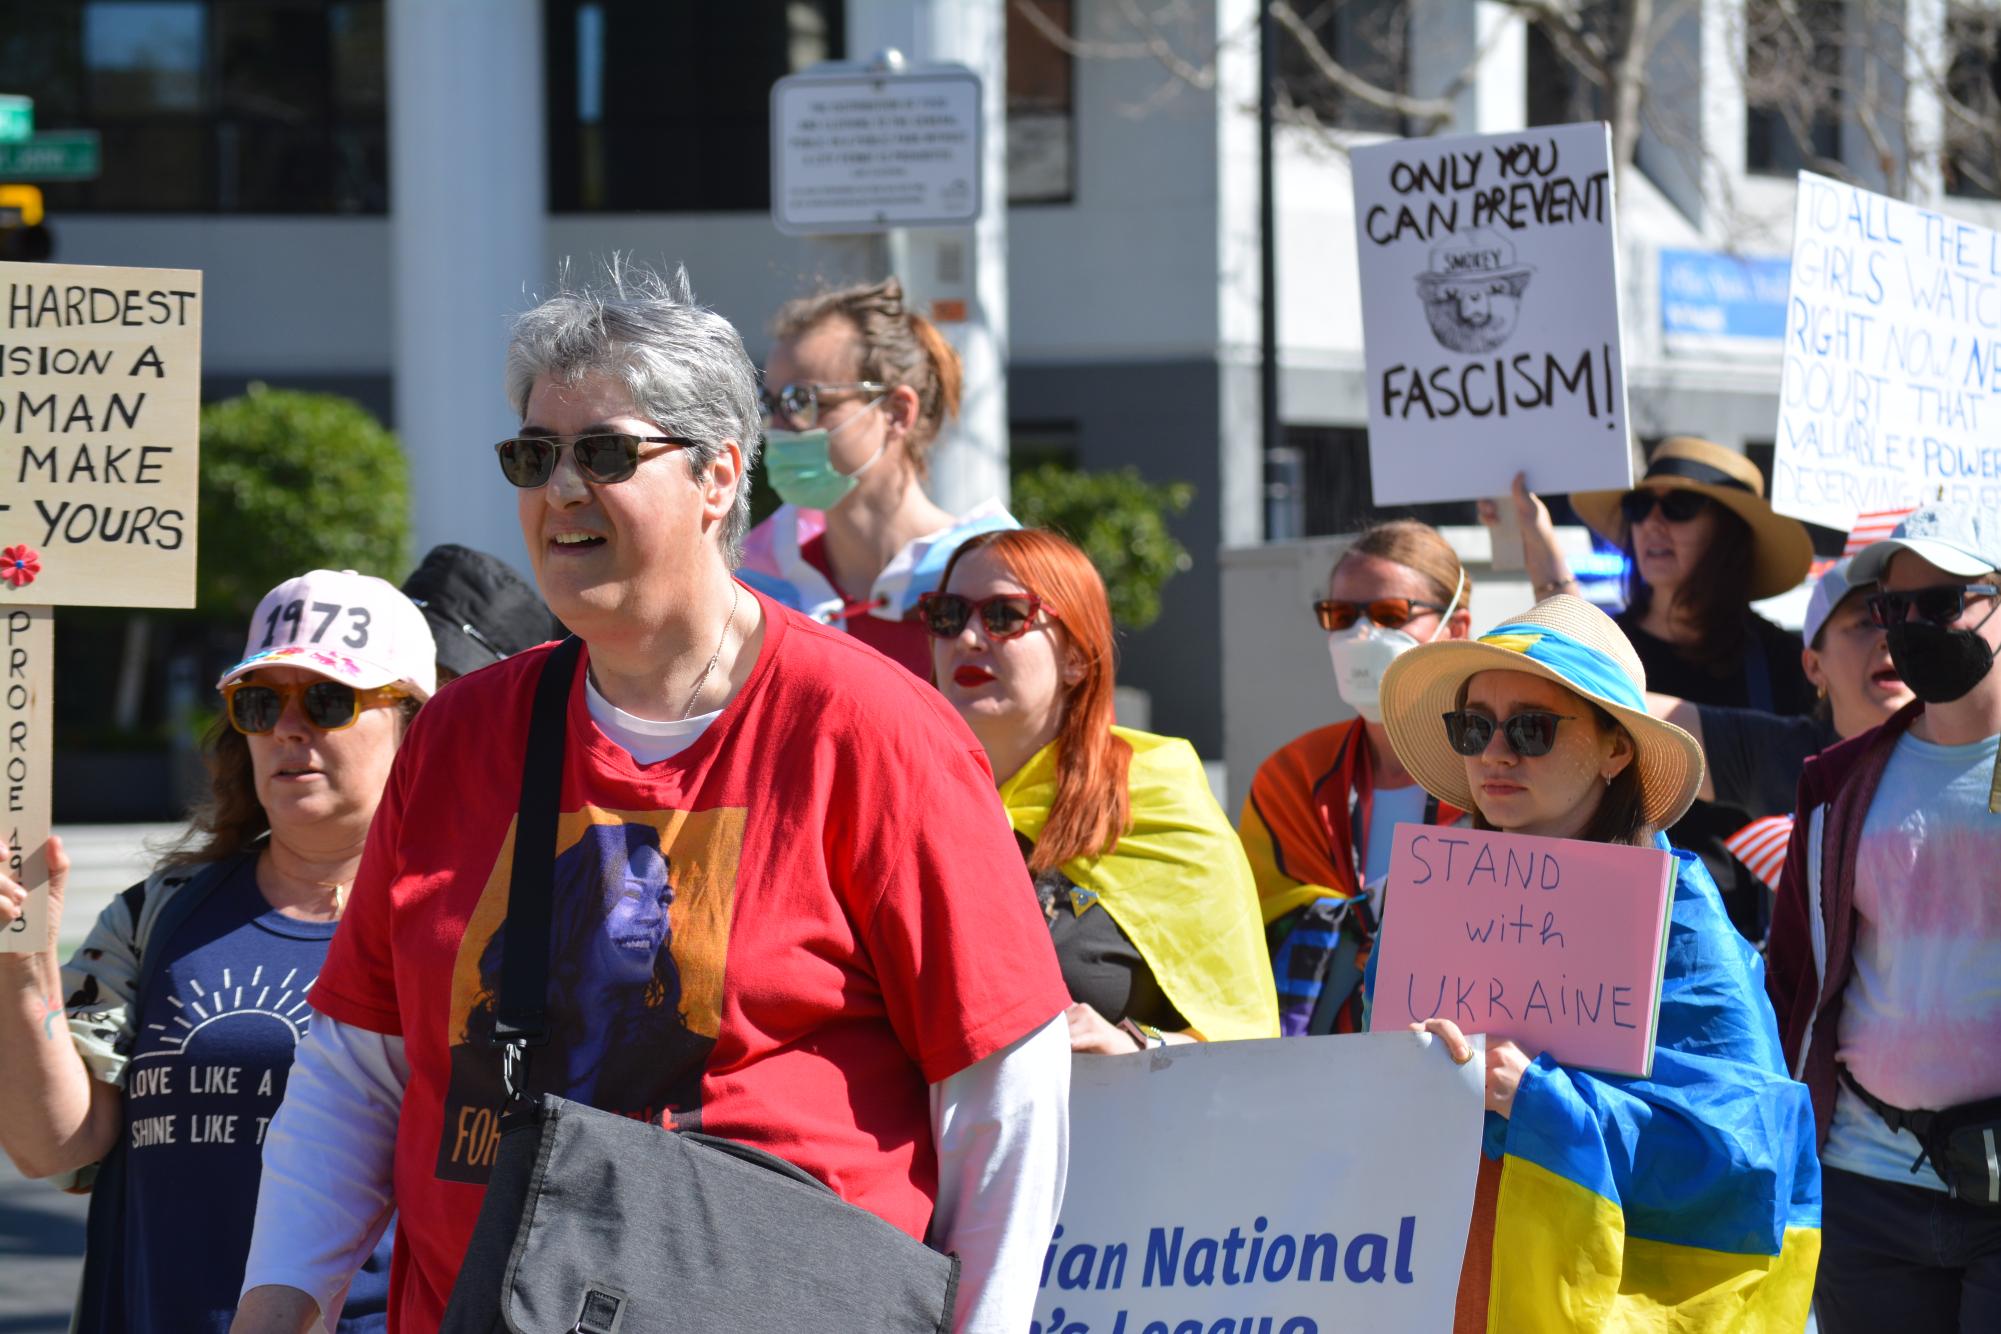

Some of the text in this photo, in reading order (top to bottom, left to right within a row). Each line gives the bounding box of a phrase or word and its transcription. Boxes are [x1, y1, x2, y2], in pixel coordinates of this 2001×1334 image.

[1390, 138, 1558, 195] ONLY YOU
[1366, 171, 1609, 245] CAN PREVENT
[1802, 183, 1838, 230] TO
[1848, 191, 1903, 243] ALL
[1919, 212, 1977, 266] THE
[1798, 240, 1885, 303] GIRLS
[9, 283, 196, 329] HARDEST
[1793, 296, 1875, 360] RIGHT
[128, 345, 165, 378] A
[1382, 342, 1616, 431] FASCISM!
[0, 391, 146, 433] MAN
[1787, 357, 1984, 430] DOUBT THAT
[17, 443, 174, 484] MAKE
[1783, 417, 1904, 472] VALUABLE
[34, 500, 185, 550] YOURS
[261, 599, 372, 649] 1973
[7, 611, 31, 933] PRO ROE 193
[1411, 835, 1560, 890] STAND
[1466, 904, 1564, 948] with
[130, 1065, 272, 1099] LOVE LIKE A
[131, 1115, 177, 1149] SHINE
[190, 1115, 239, 1144] LIKE
[1141, 1215, 1417, 1288] National
